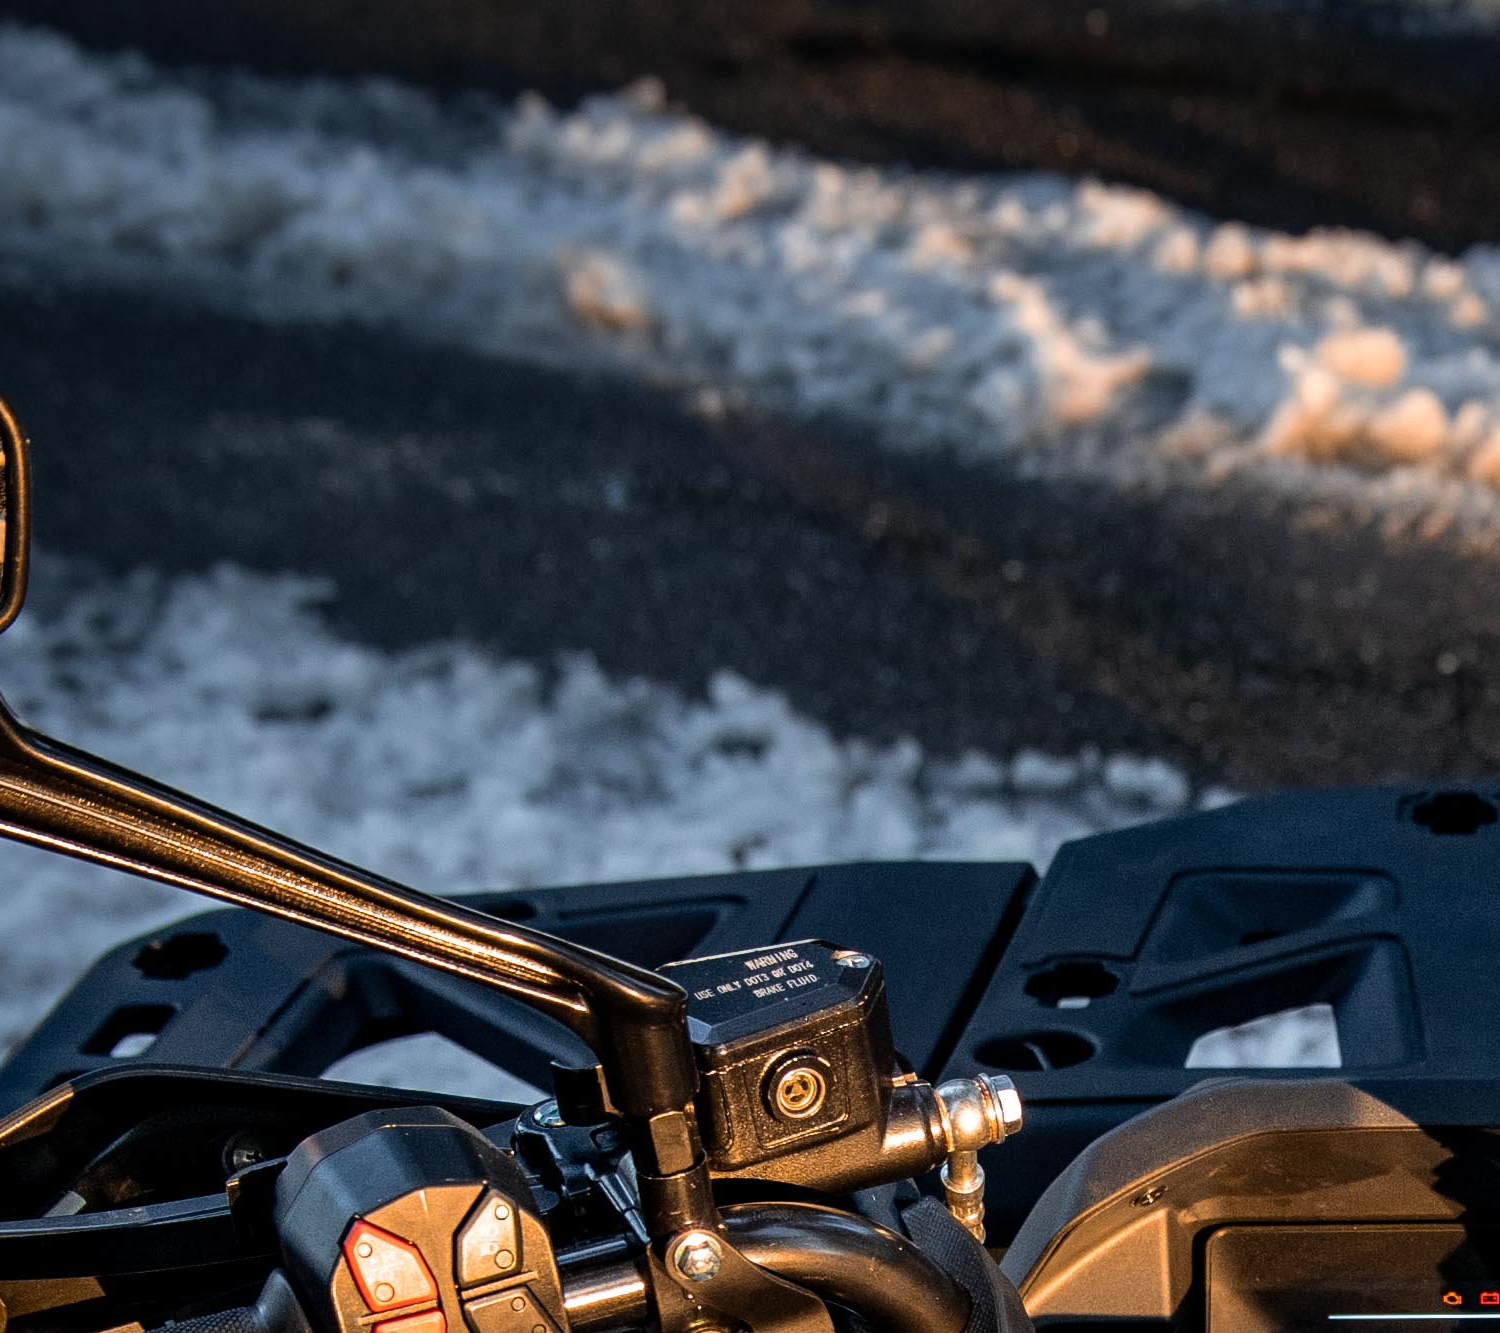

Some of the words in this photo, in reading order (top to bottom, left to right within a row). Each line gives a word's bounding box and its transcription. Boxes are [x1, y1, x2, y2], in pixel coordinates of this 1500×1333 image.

[744, 949, 798, 970] WARNING
[694, 989, 716, 1000] USE
[717, 981, 741, 994] ONLY
[744, 973, 769, 986] DOT3
[787, 961, 814, 974] DOT4
[753, 984, 785, 998] BRAKE
